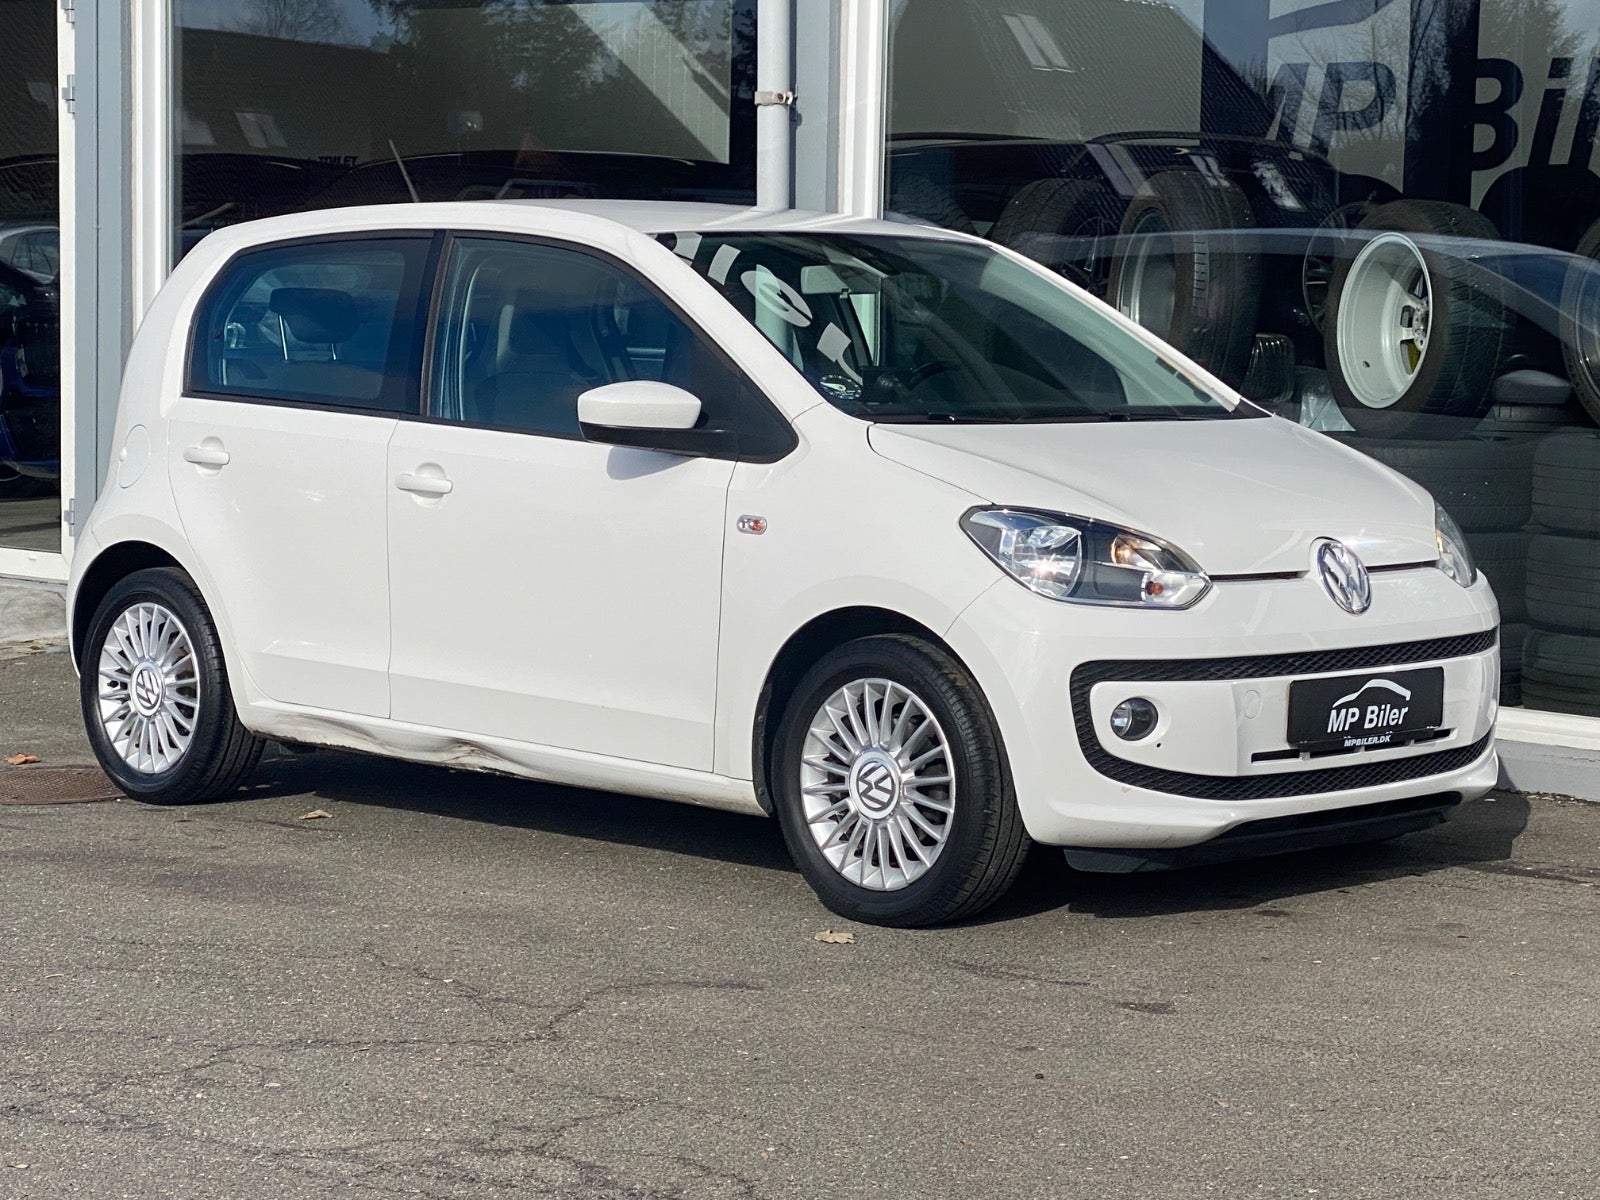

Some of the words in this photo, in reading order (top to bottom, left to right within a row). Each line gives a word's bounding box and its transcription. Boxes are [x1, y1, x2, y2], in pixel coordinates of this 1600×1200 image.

[1327, 707, 1360, 733] MP
[1364, 704, 1409, 729] Biler
[1344, 735, 1392, 747] MPBILER.DK
